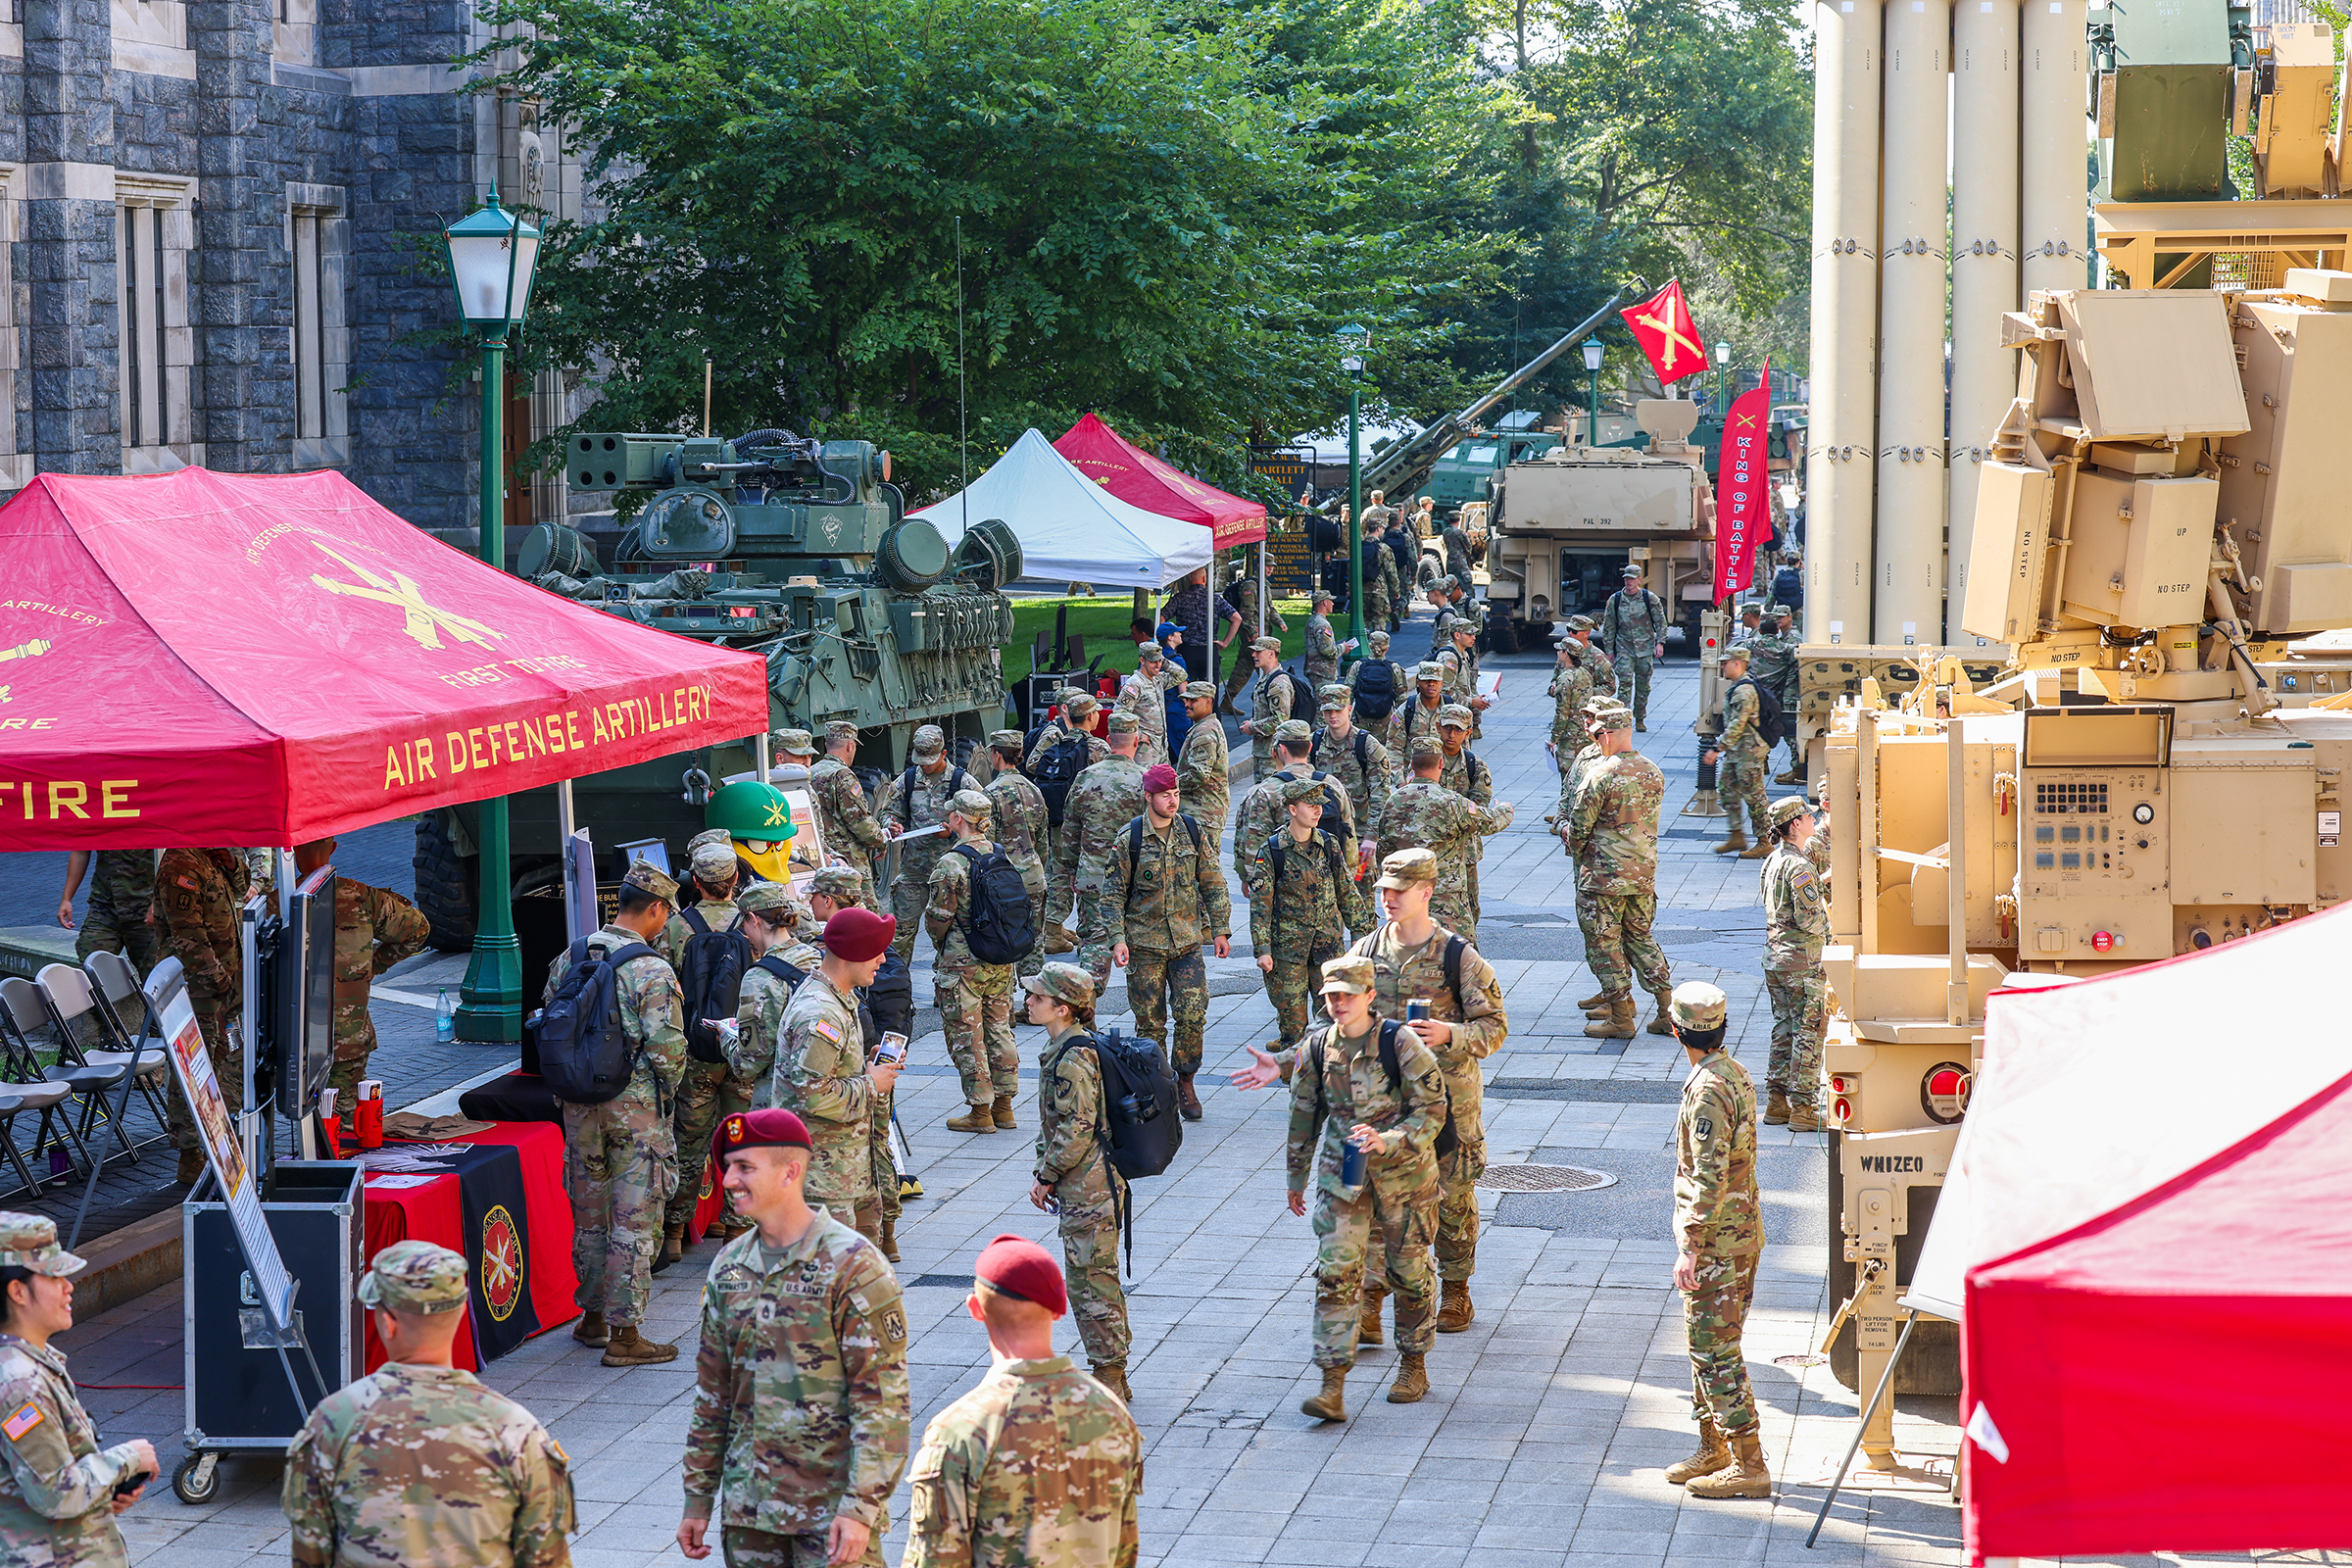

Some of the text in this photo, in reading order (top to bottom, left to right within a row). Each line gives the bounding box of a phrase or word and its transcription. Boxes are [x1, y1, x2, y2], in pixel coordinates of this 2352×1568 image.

[1085, 460, 1129, 471] ARTILLERY
[1254, 466, 1306, 474] BARTLETT
[1726, 437, 1752, 588] KING OF BATTLE
[251, 522, 300, 551] DEFENSE
[1215, 525, 1225, 537] AIR
[1225, 520, 1245, 535] DEFENSE
[2177, 527, 2187, 536] UP
[247, 548, 262, 567] AIR
[2020, 530, 2032, 578] NO STEP
[2172, 584, 2190, 593] STEP
[1, 599, 109, 627] ARTILLERY
[2051, 652, 2081, 663] NO STEP
[438, 655, 588, 689] FIRST TO FIRE
[383, 684, 711, 791] AIR DEFENSE ARTILLERY
[802, 1285, 824, 1296] ARMY
